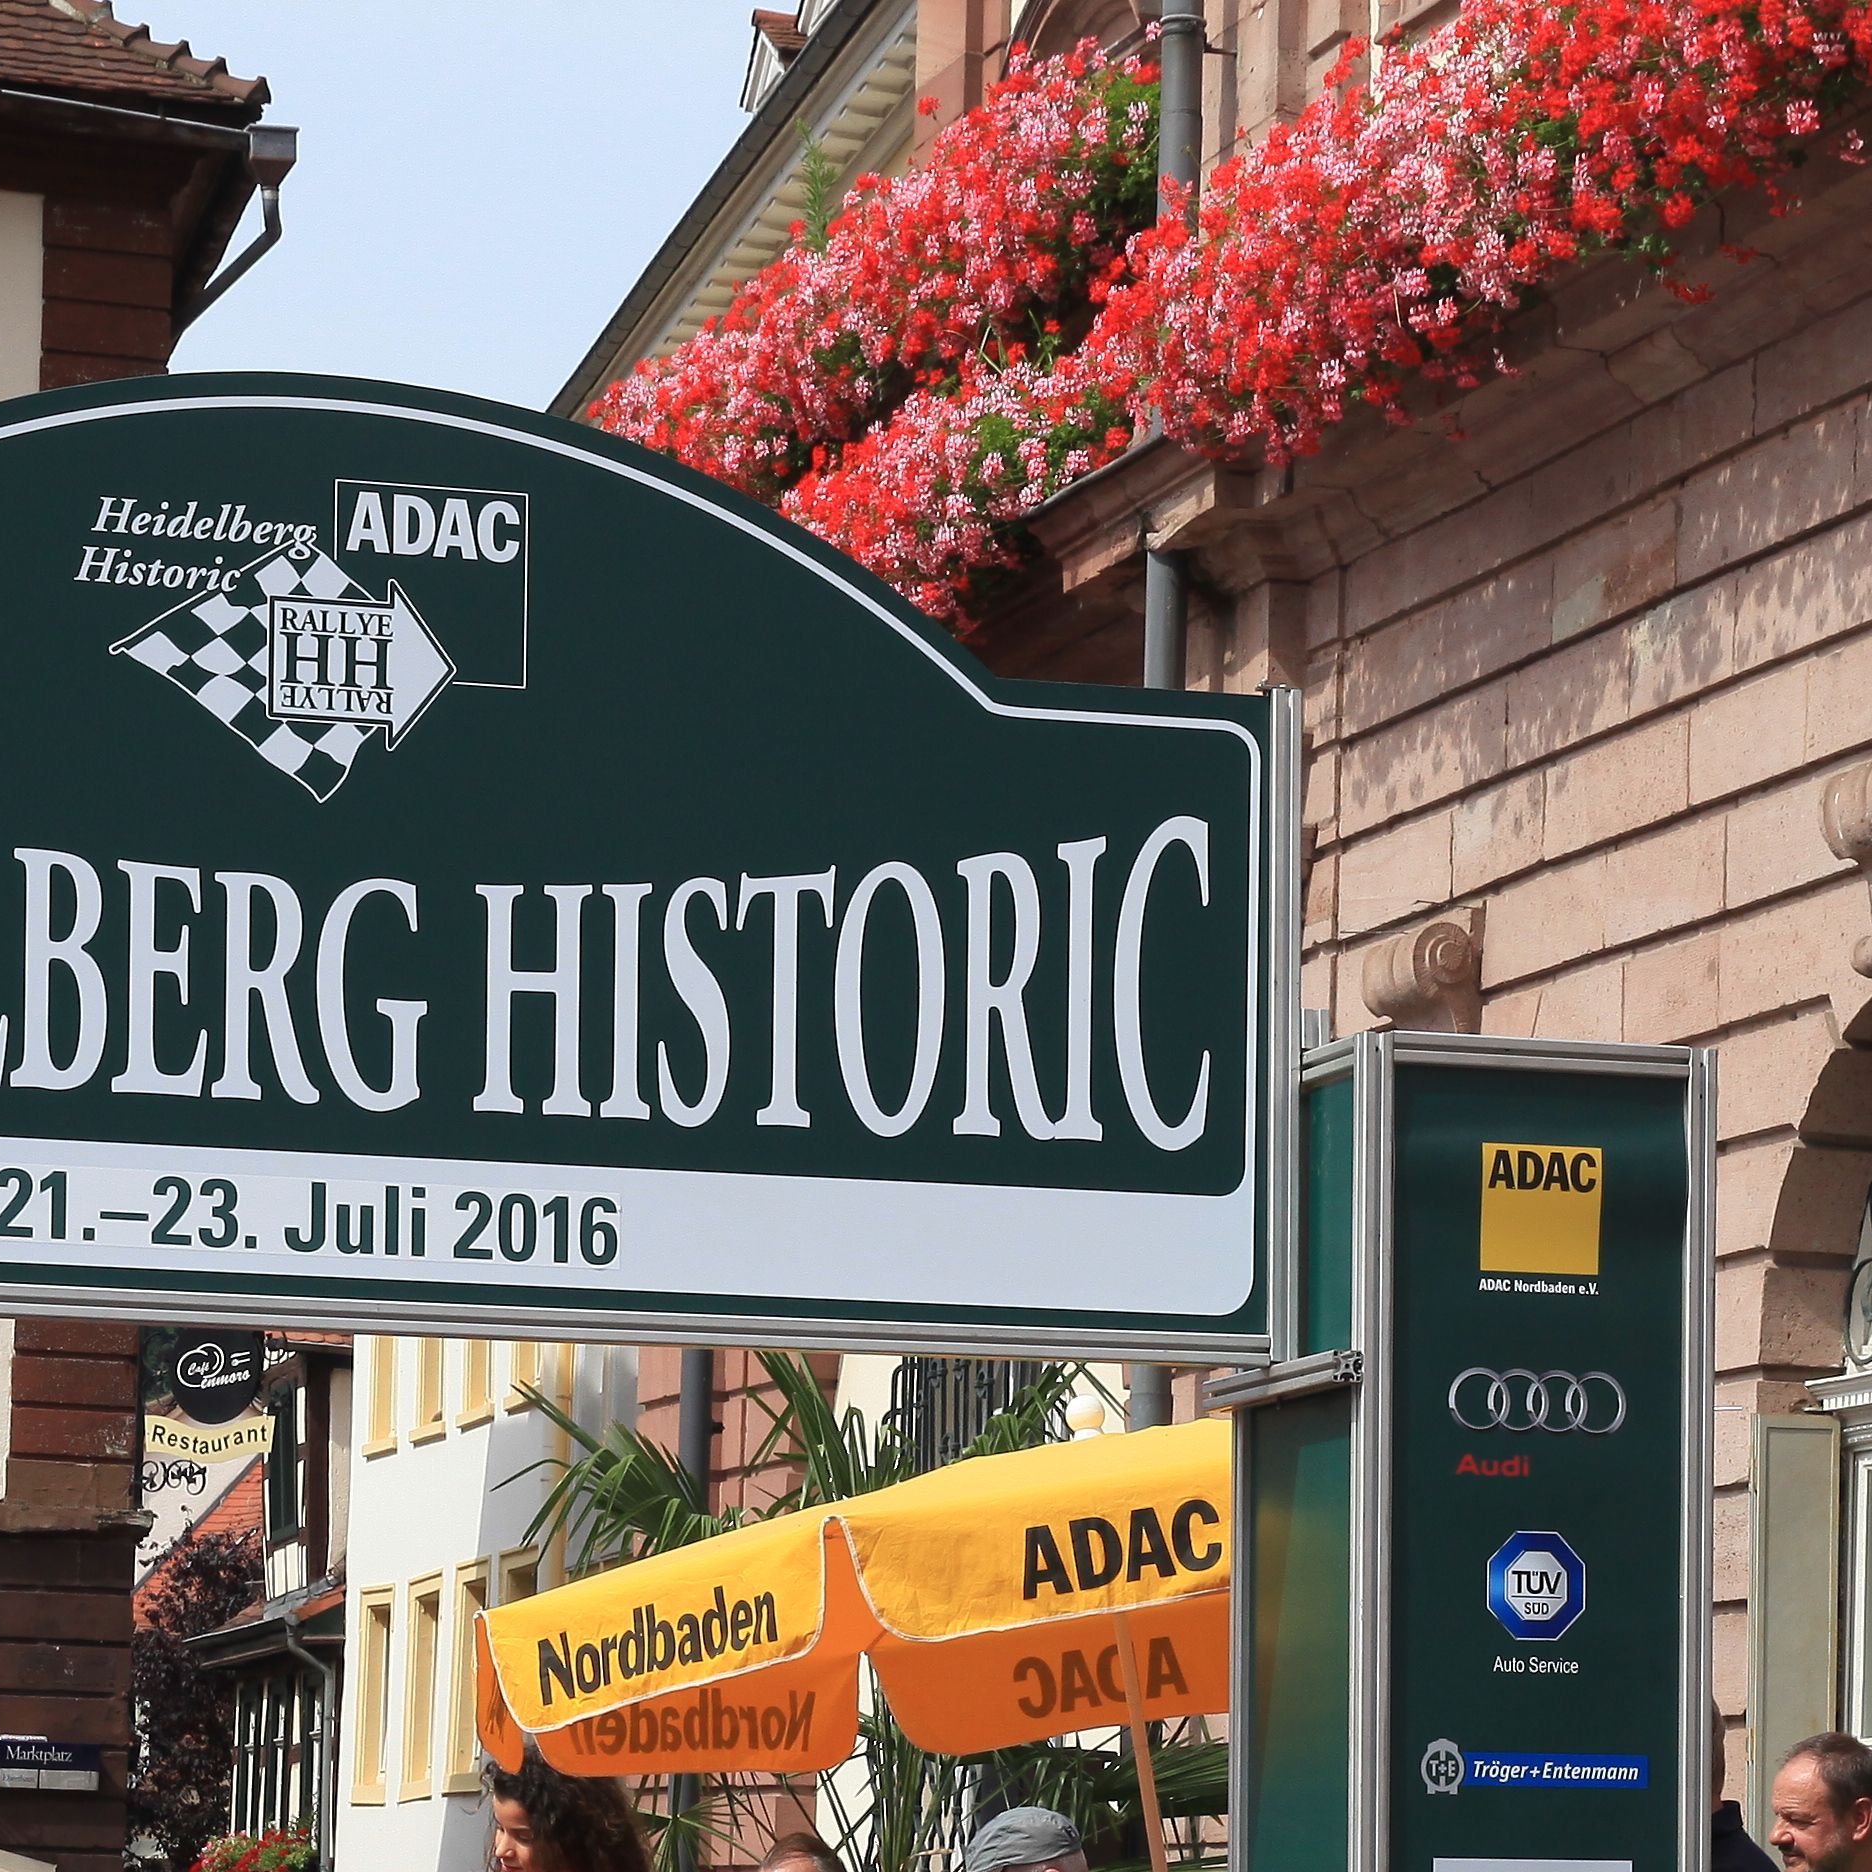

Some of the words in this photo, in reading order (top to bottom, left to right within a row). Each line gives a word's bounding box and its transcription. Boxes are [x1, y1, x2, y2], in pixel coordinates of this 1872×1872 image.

[90, 496, 318, 560] Heidelberg
[345, 490, 522, 564] ADAC
[73, 546, 241, 592] Historic
[279, 606, 394, 638] RALLYE
[279, 631, 394, 691] HH
[472, 813, 1213, 1153] HISTORIC
[1488, 1149, 1597, 1193] ADAC
[284, 1176, 430, 1262] Juli
[452, 1190, 620, 1268] 2016
[1478, 1278, 1512, 1292] ADAC
[1514, 1279, 1576, 1295] Nordbaden
[1578, 1282, 1600, 1296] e.V.
[150, 1423, 268, 1455] Restaurant
[1455, 1453, 1532, 1478] Audi
[1023, 1498, 1223, 1602] ADAC
[1511, 1569, 1562, 1595] TÜV
[1524, 1601, 1549, 1616] SÜD
[537, 1585, 778, 1706] Nordbaden
[1493, 1655, 1525, 1674] Auto
[1529, 1656, 1579, 1675] Service
[6, 1745, 73, 1764] Marktplatz
